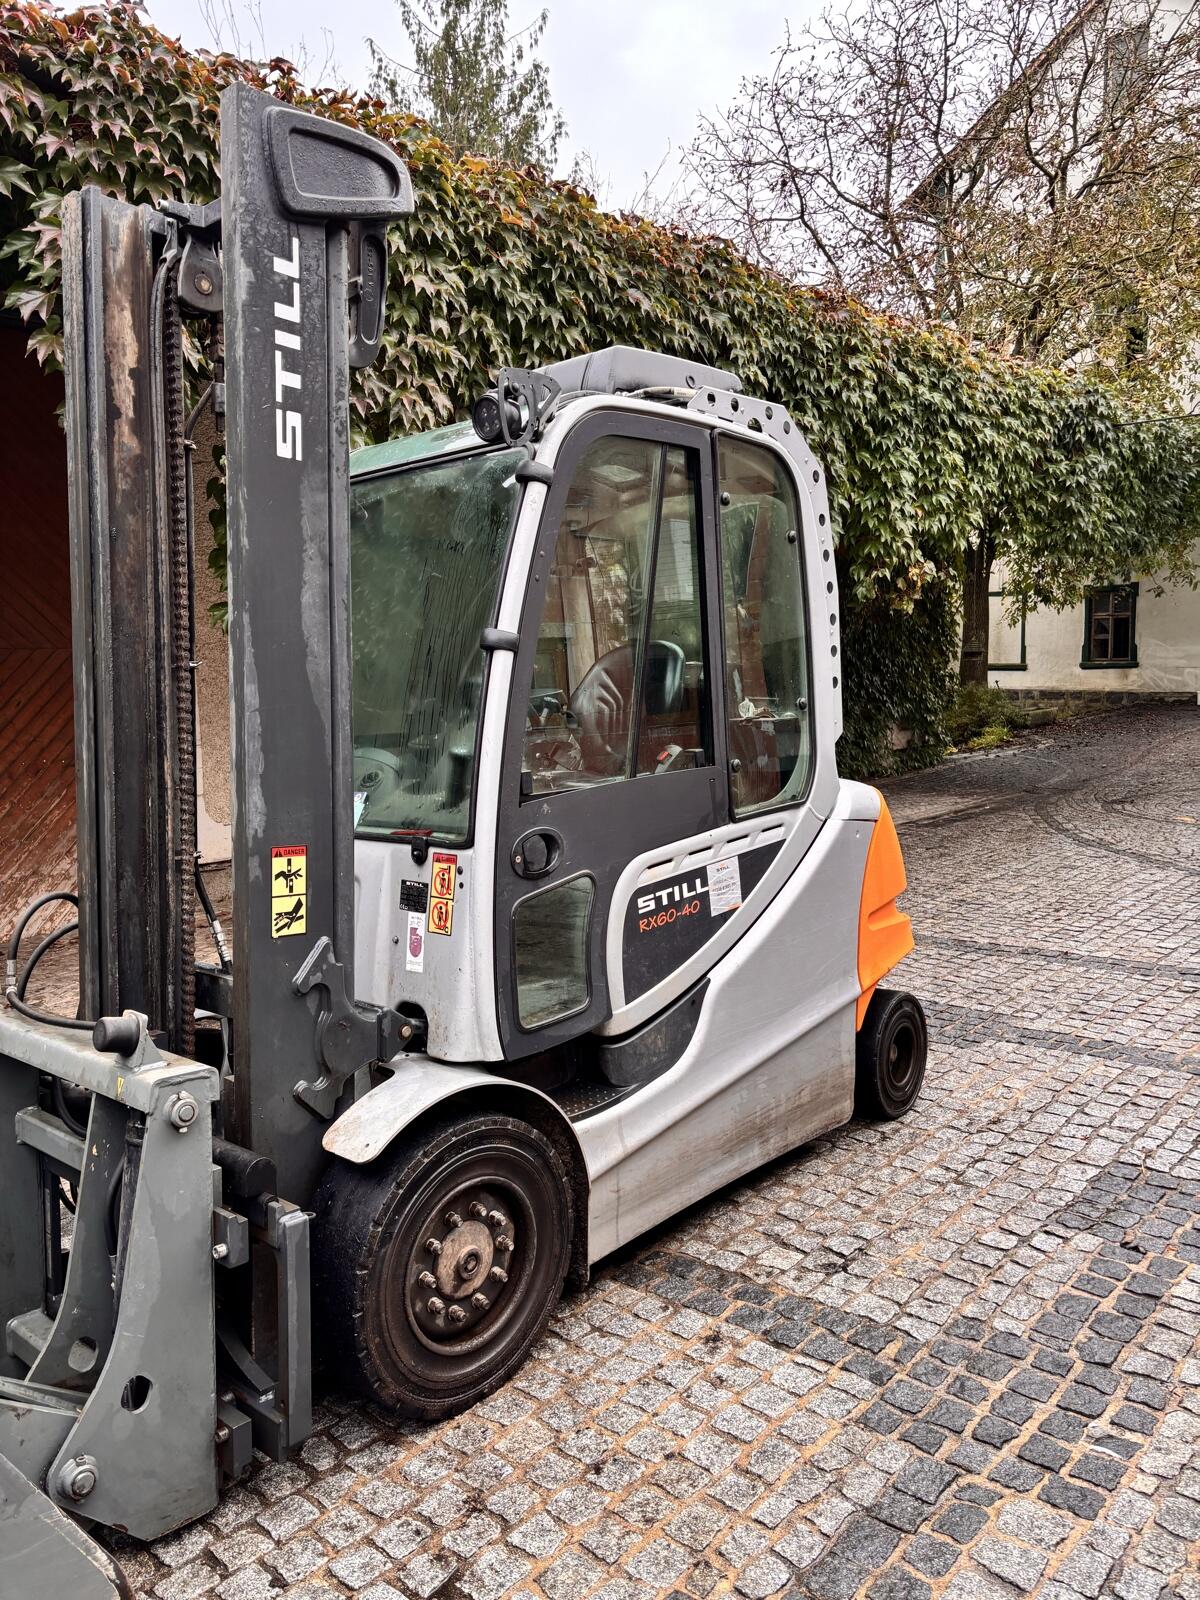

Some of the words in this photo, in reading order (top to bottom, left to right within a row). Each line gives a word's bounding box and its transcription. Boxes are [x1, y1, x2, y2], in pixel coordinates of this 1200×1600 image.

[273, 237, 302, 461] STILL
[283, 848, 305, 856] DANGER
[637, 877, 709, 914] STILL
[638, 900, 701, 933] RX60-40
